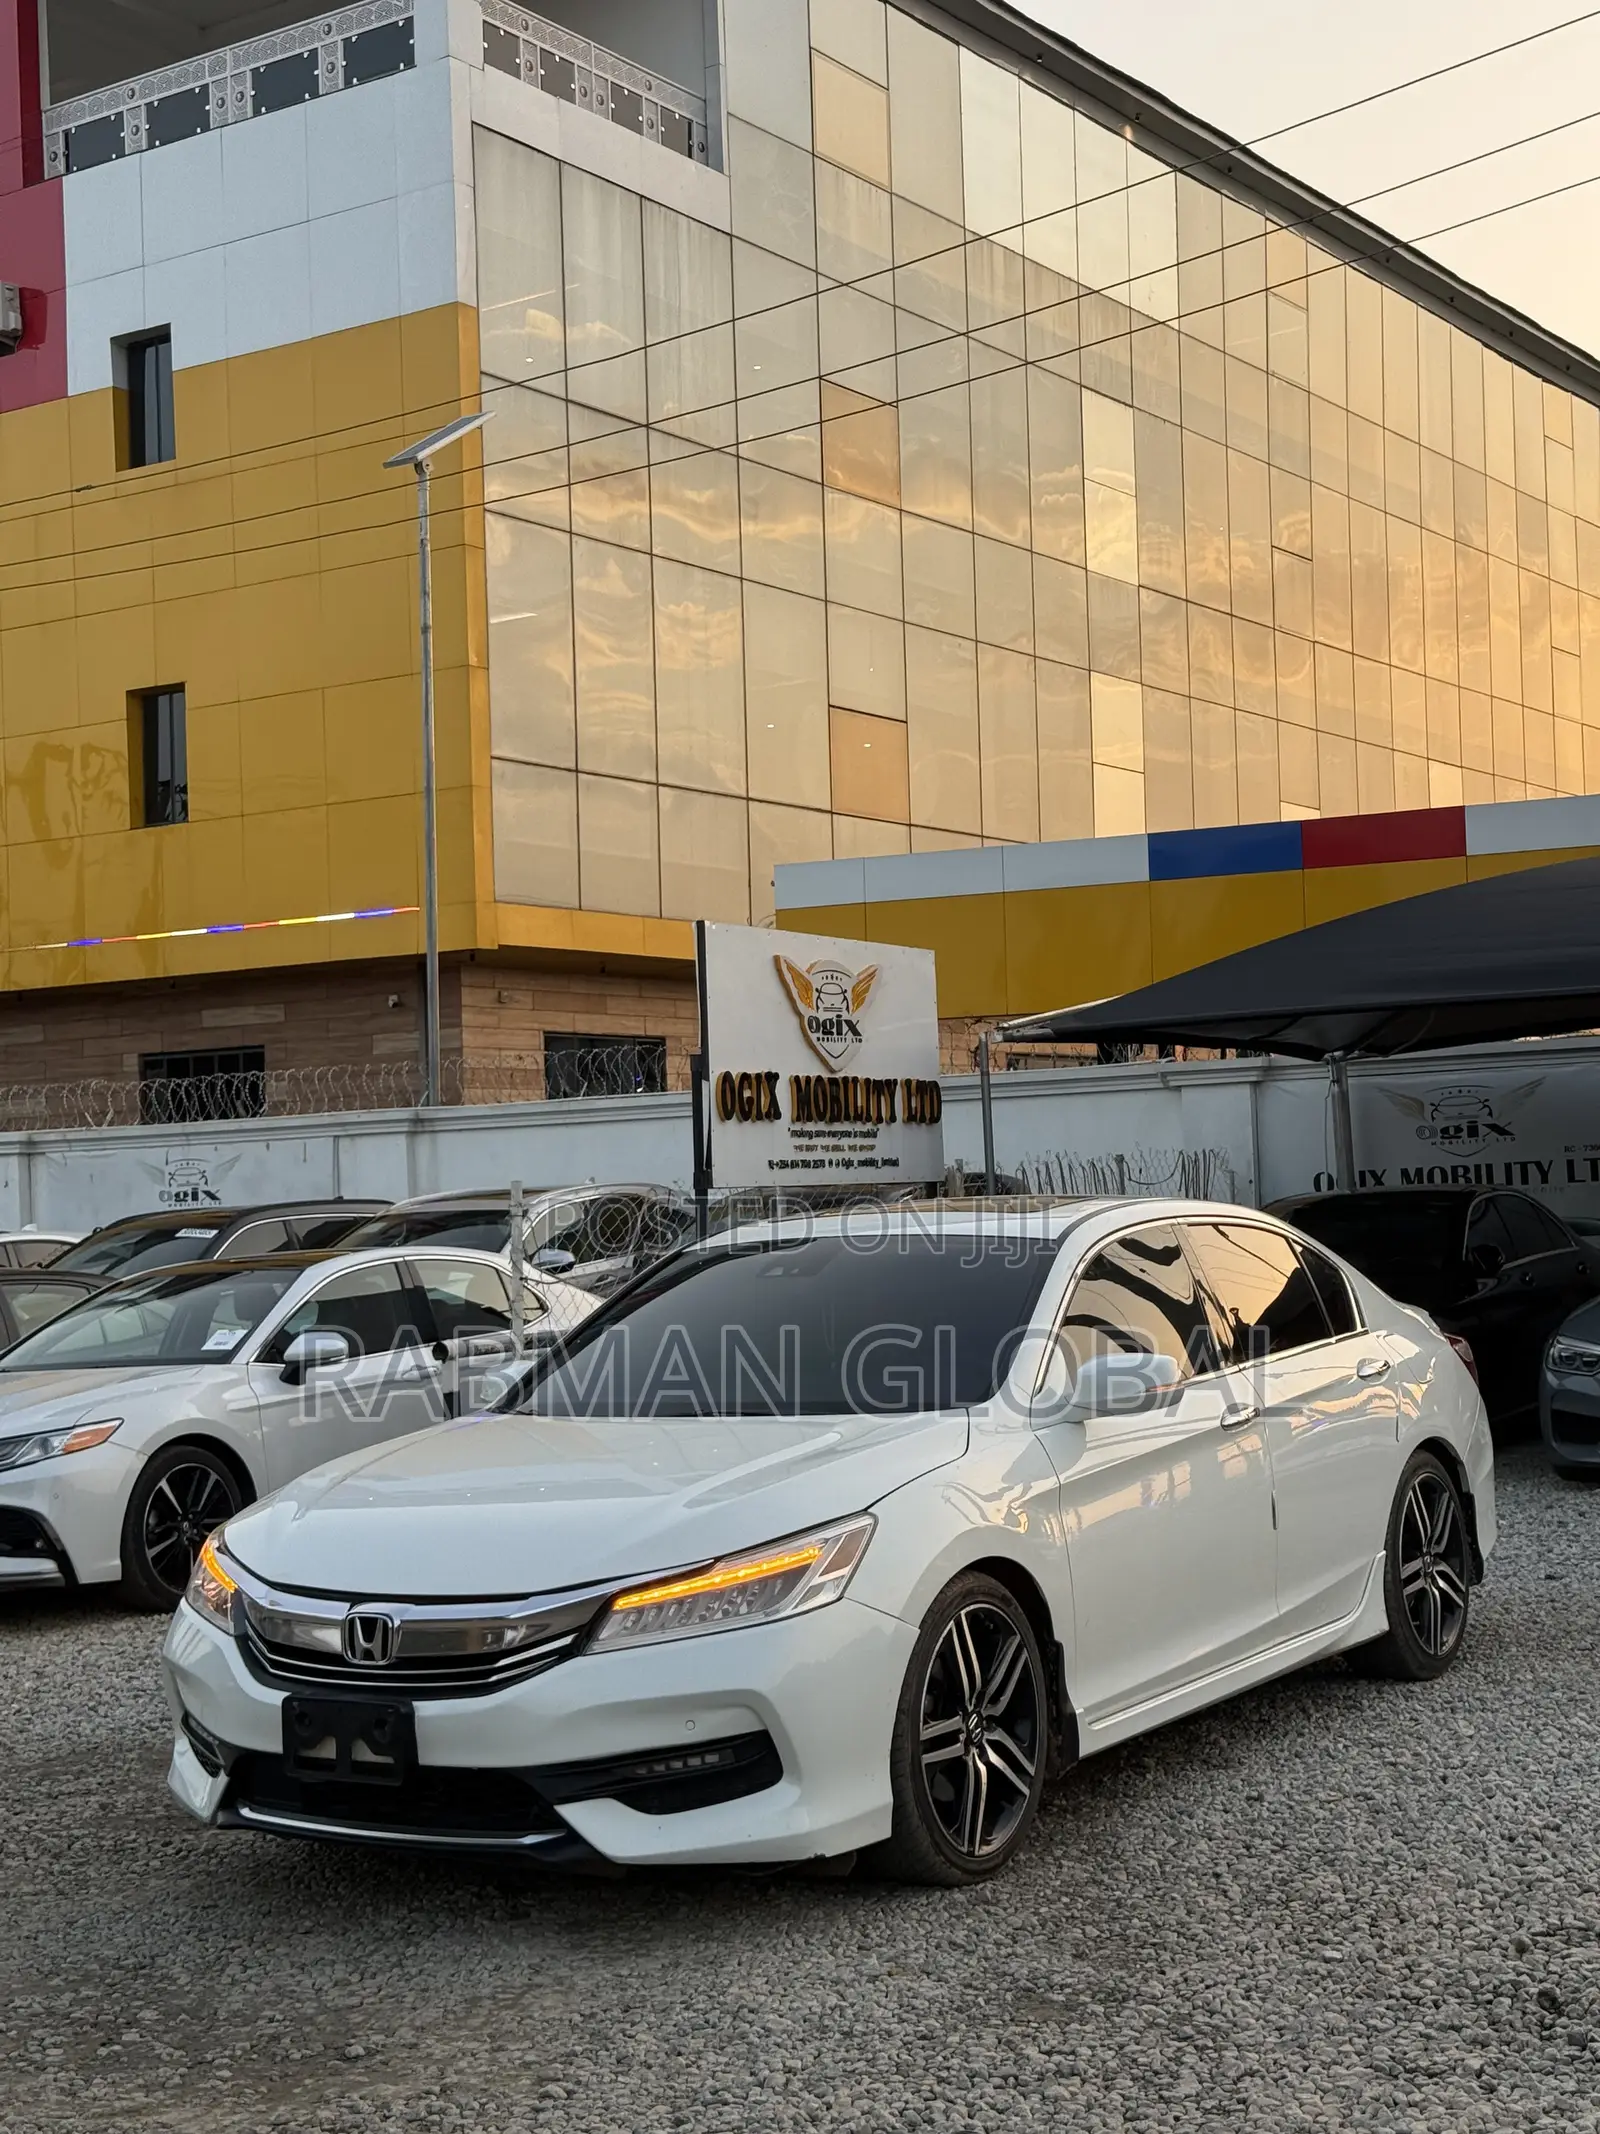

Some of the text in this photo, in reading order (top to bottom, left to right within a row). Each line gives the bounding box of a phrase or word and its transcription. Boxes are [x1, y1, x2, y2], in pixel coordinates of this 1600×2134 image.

[808, 1014, 863, 1037] Ogix
[716, 1070, 942, 1125] OGIX MOBILITY LTD
[1564, 1145, 1576, 1153] RC
[1313, 1168, 1388, 1193] OIX
[1400, 1159, 1554, 1187] MOBILITY
